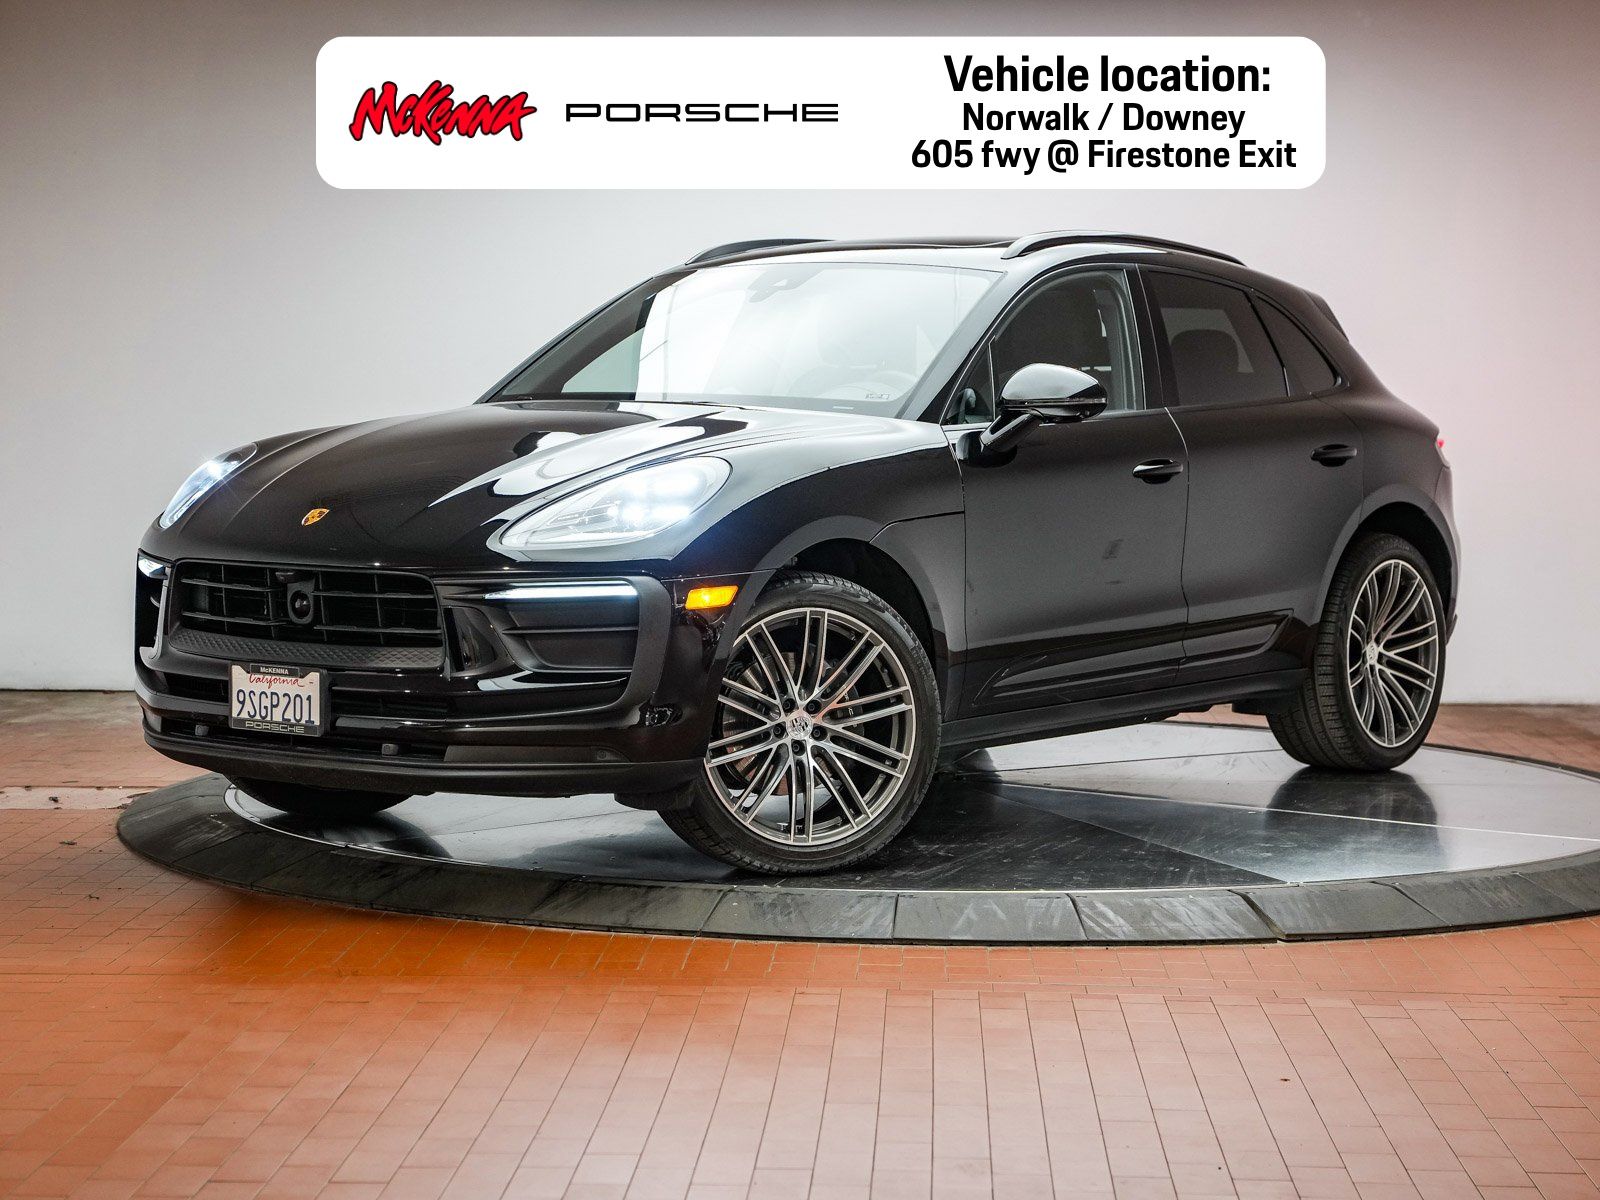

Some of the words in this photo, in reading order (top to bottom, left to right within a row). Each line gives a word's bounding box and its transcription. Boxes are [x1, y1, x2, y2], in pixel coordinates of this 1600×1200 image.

[260, 667, 289, 675] McKENNA
[236, 689, 315, 725] 9SGP201
[245, 721, 305, 733] PORSCHE
